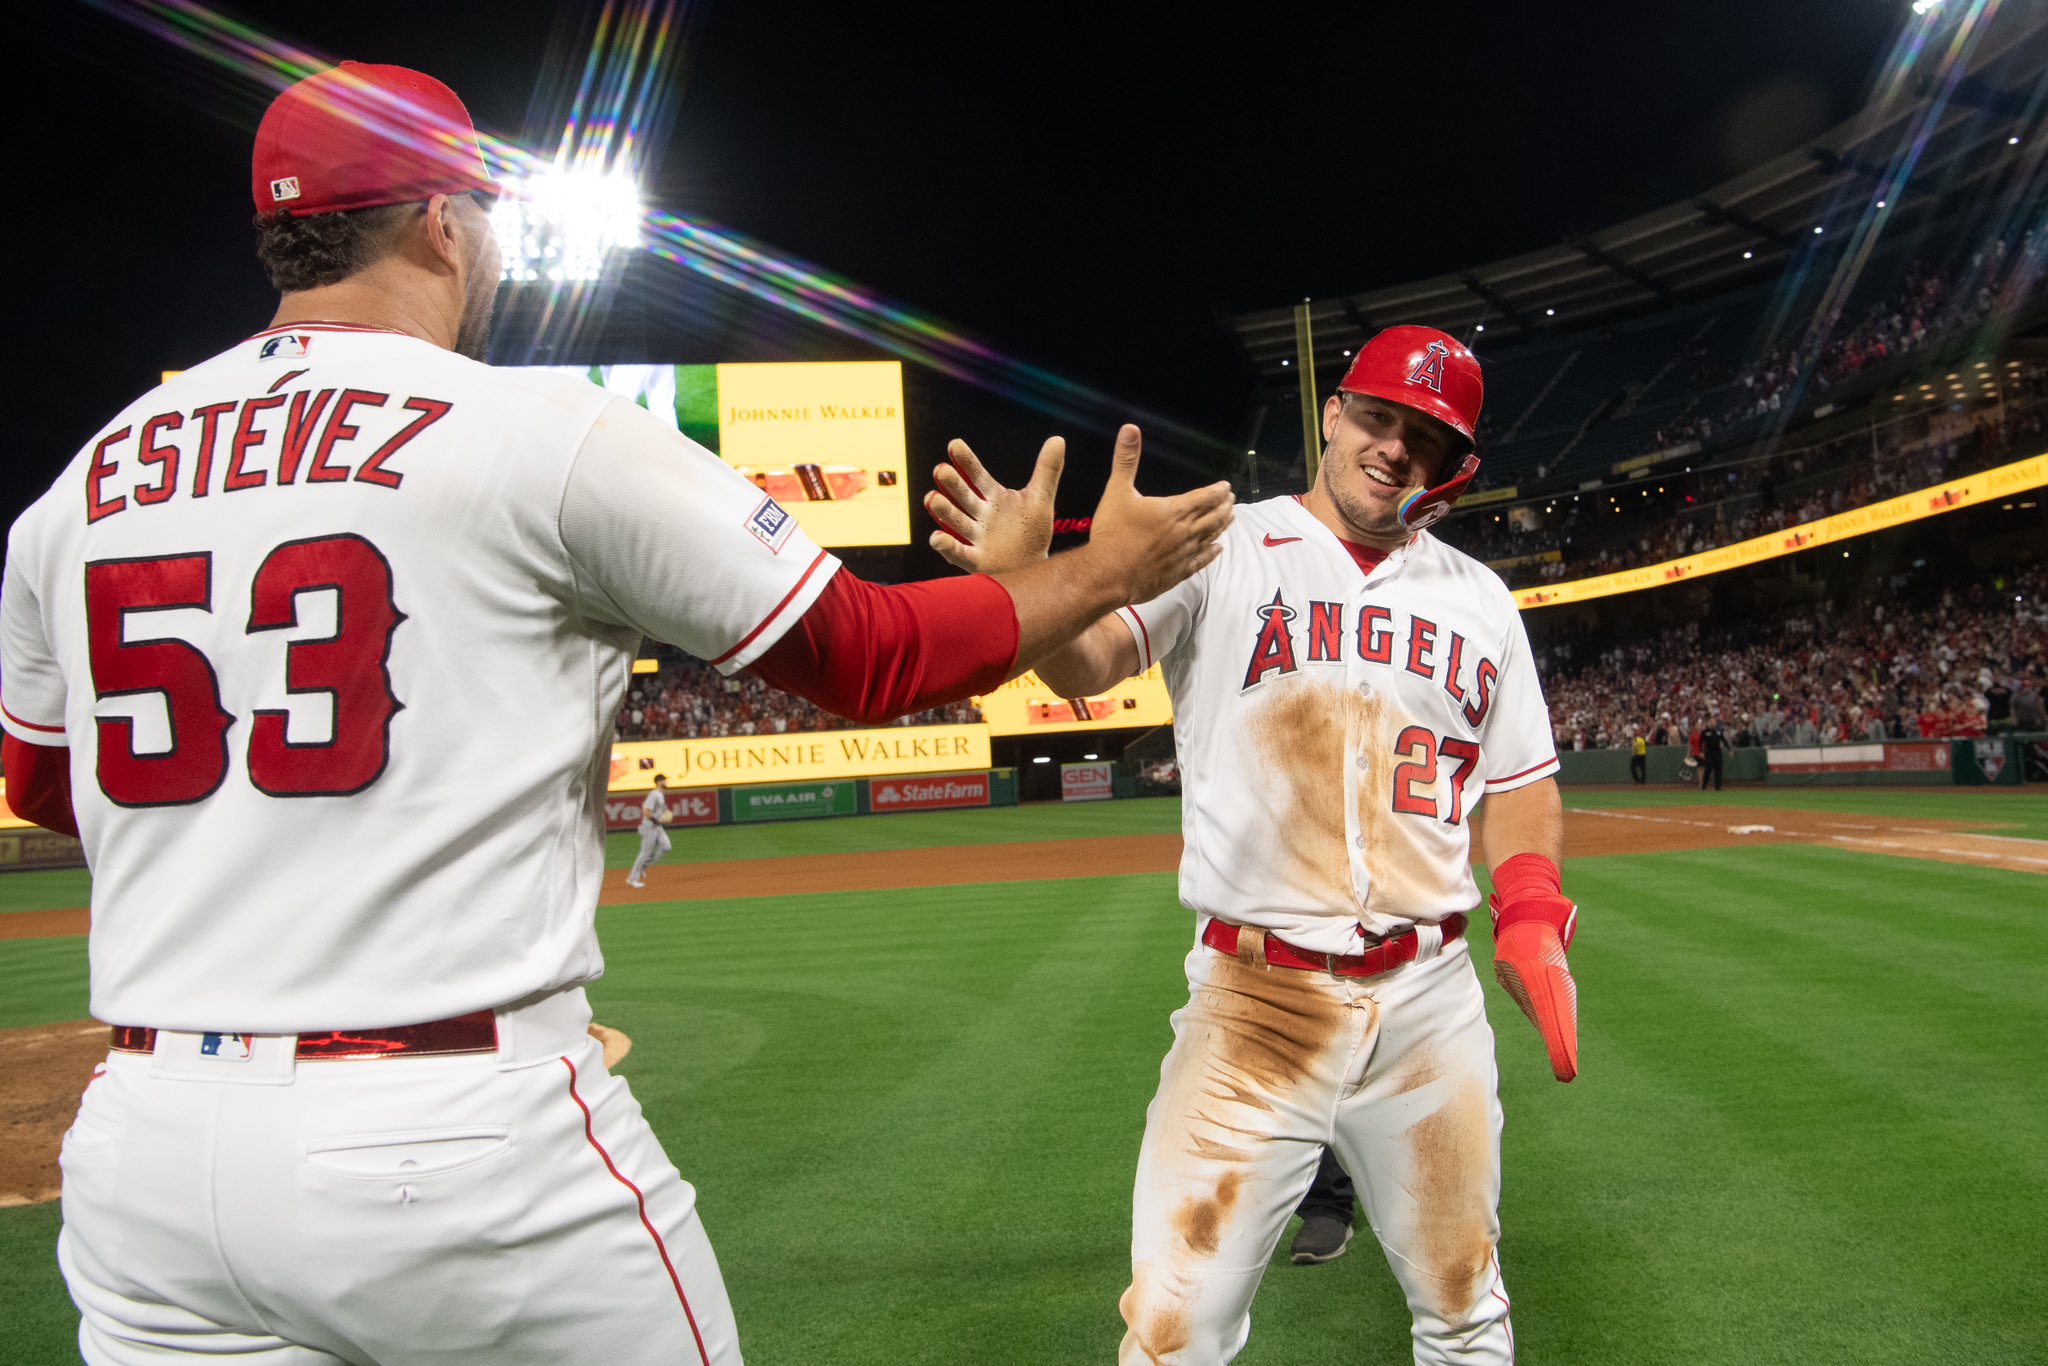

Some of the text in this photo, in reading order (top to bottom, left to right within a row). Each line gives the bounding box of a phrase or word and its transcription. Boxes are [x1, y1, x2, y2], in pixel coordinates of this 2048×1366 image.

[1408, 340, 1449, 393] A
[729, 405, 896, 426] JOHNNIE WALKER
[87, 368, 453, 525] ESTÉVEZ
[757, 502, 786, 532] FBM
[85, 532, 408, 808] 53
[1240, 587, 1499, 729] ANGELS
[678, 736, 969, 778] JOHNNIE WALKER
[1063, 767, 1108, 784] GEN
[1392, 725, 1480, 826] 27
